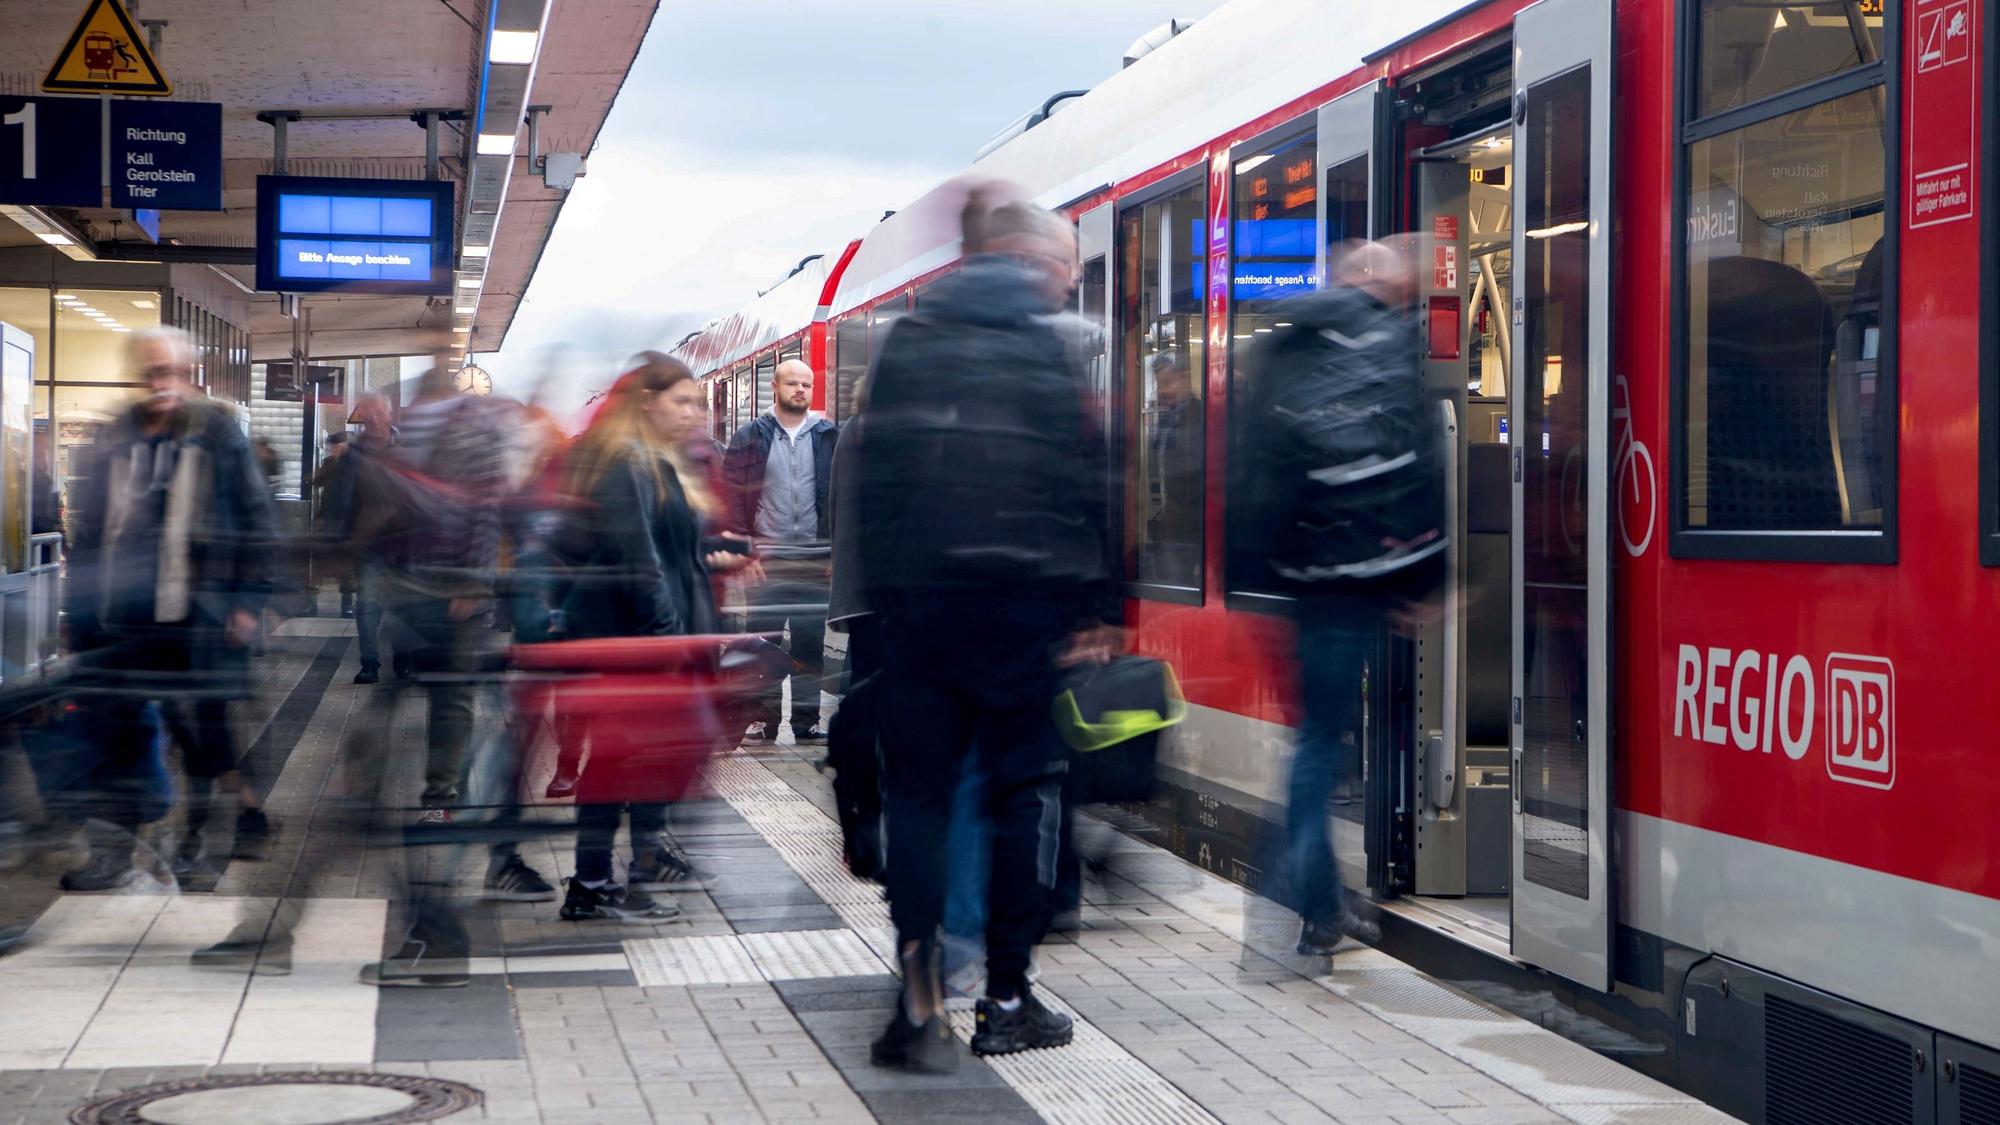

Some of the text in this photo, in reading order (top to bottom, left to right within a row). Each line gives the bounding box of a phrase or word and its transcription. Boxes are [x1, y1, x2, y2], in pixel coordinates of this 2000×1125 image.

[4, 102, 37, 180] 1
[126, 127, 187, 145] Richtung
[126, 151, 154, 166] Kall
[126, 167, 196, 183] Gerolstein
[126, 184, 158, 197] Trier
[299, 252, 411, 266] Bitte Ansage beachten
[328, 368, 339, 396] 1
[1674, 643, 1887, 767] REGIO DB
